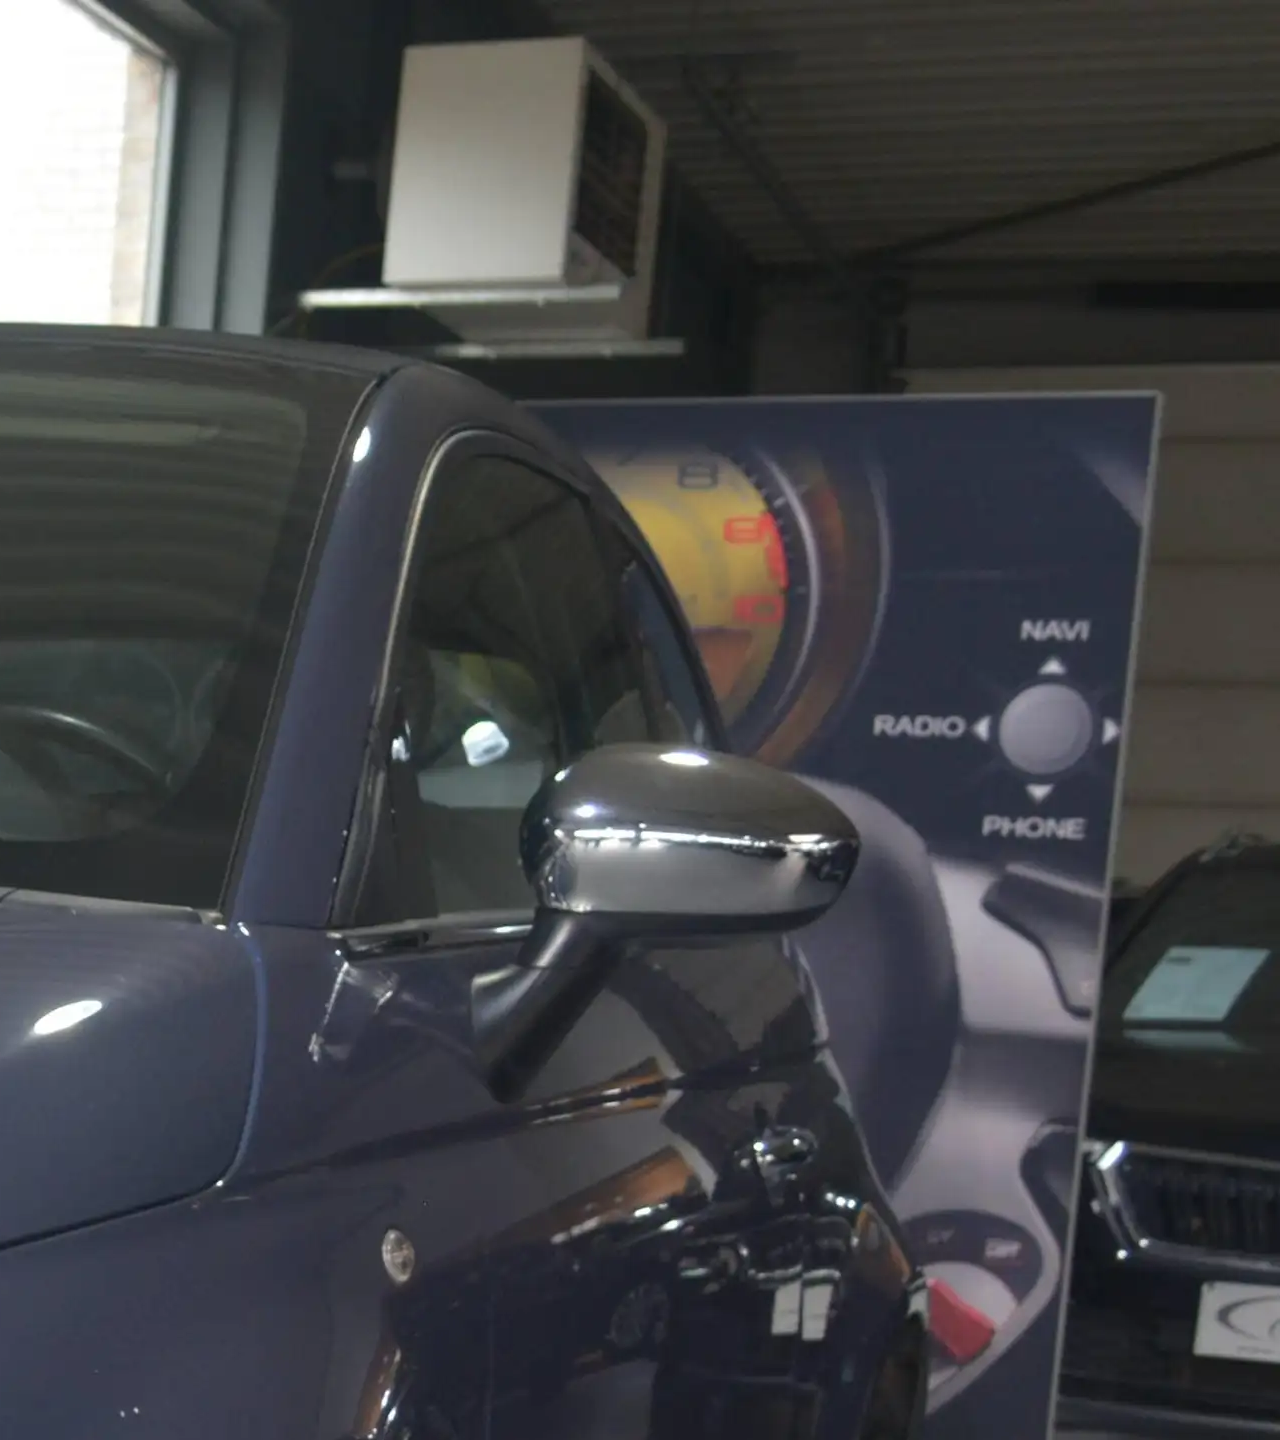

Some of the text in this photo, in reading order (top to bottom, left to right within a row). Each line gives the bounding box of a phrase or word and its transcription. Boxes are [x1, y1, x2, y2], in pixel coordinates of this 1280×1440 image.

[1020, 618, 1091, 642] NAVI
[872, 713, 967, 739] RADIO
[981, 813, 1088, 841] PHONE
